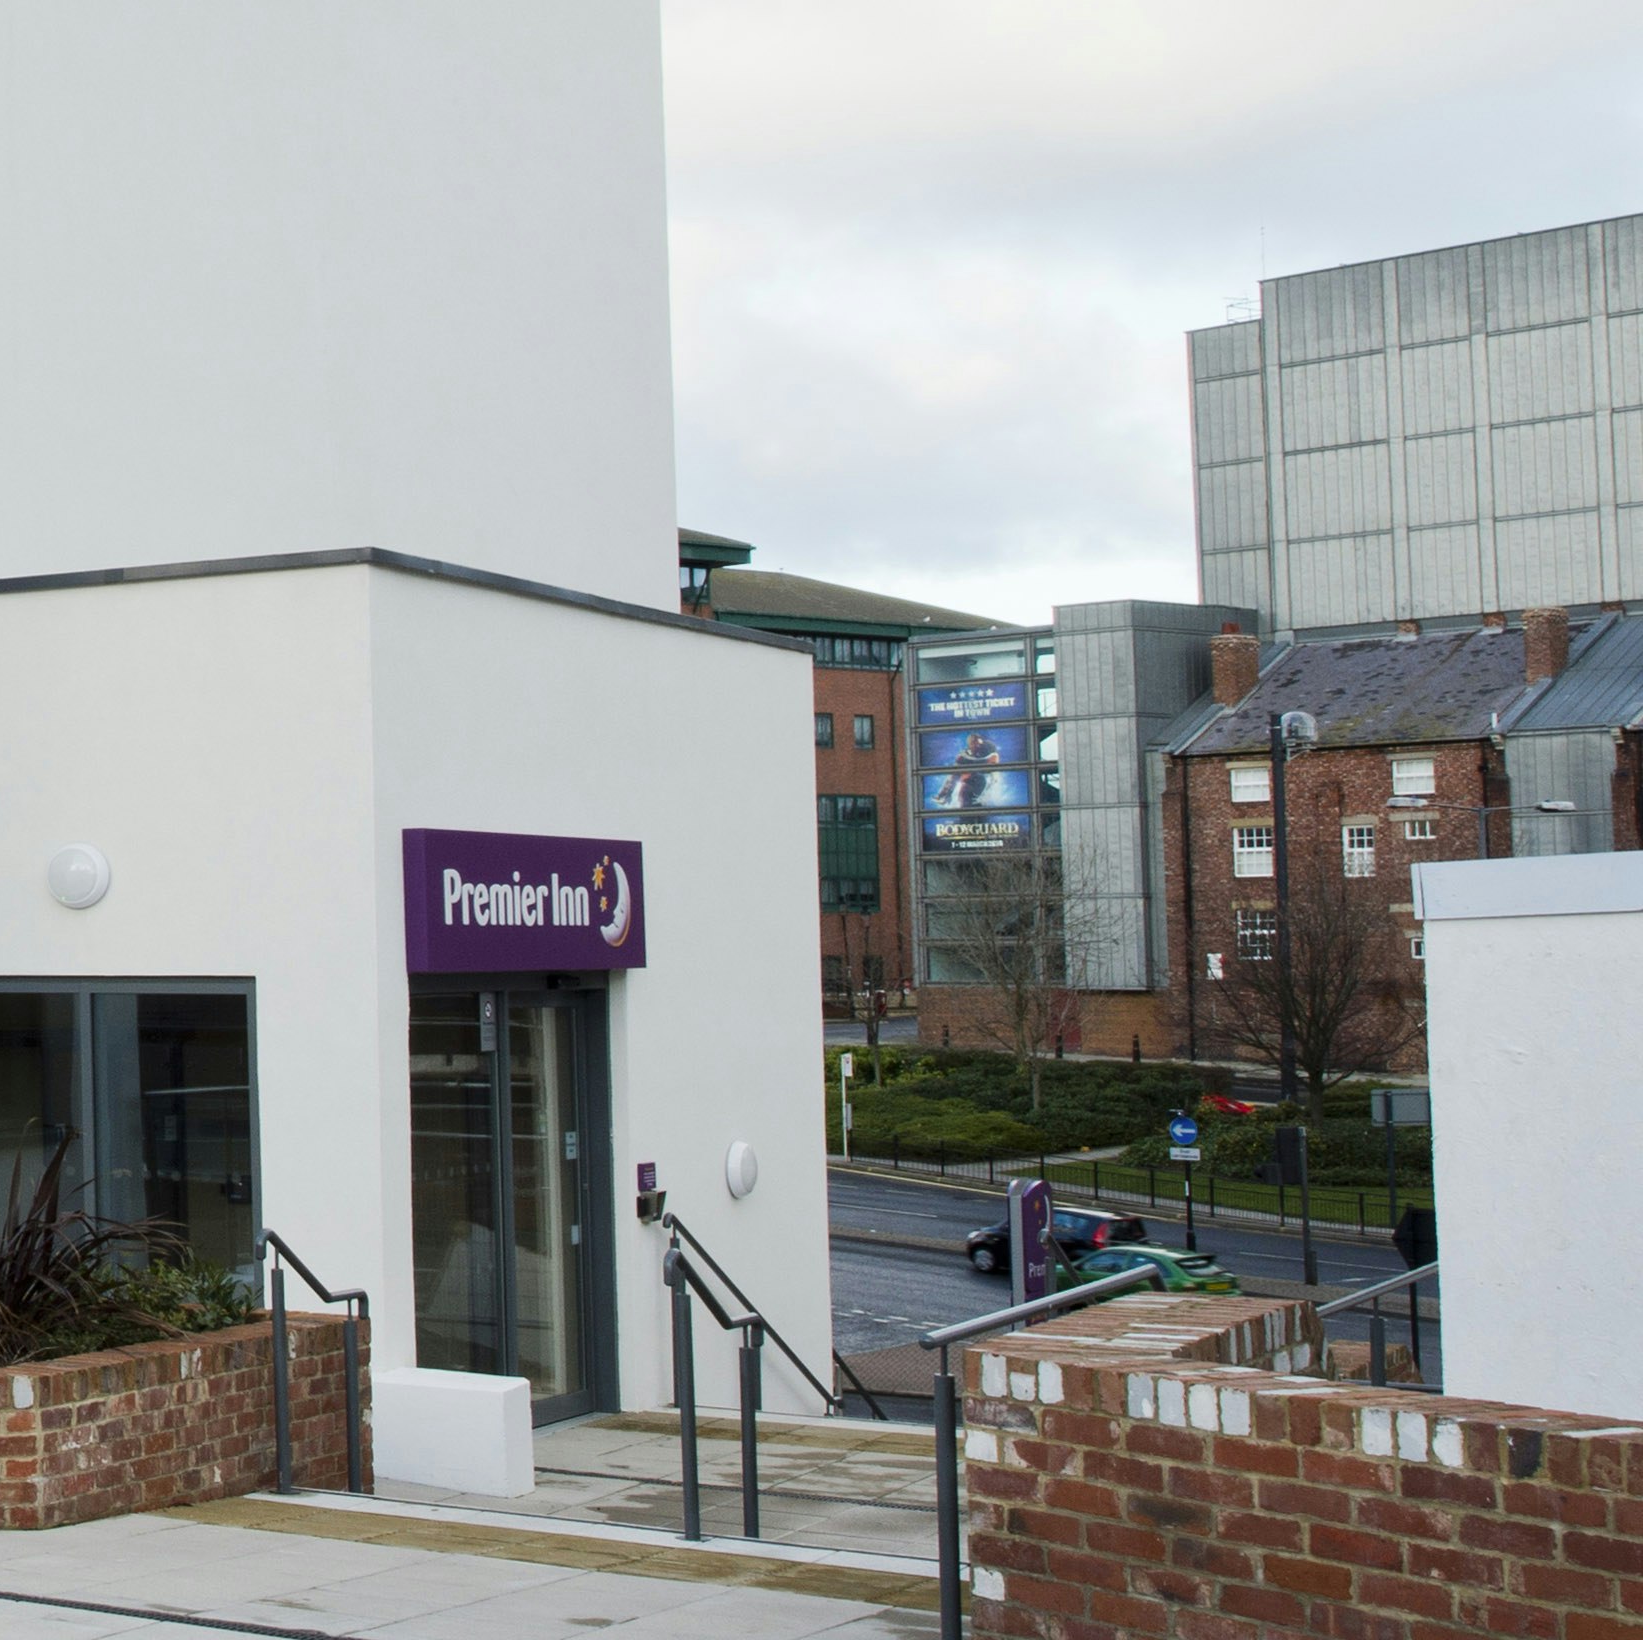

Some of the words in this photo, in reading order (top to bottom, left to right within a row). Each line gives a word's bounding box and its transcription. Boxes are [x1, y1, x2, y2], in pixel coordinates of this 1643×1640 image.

[929, 703, 946, 712] THE
[947, 700, 984, 711] HOTTEST
[985, 697, 1015, 708] TICKET
[966, 707, 991, 717] TOWN
[936, 823, 1019, 837] BODYGUARD
[443, 868, 549, 927] Premier
[551, 873, 590, 927] Inn
